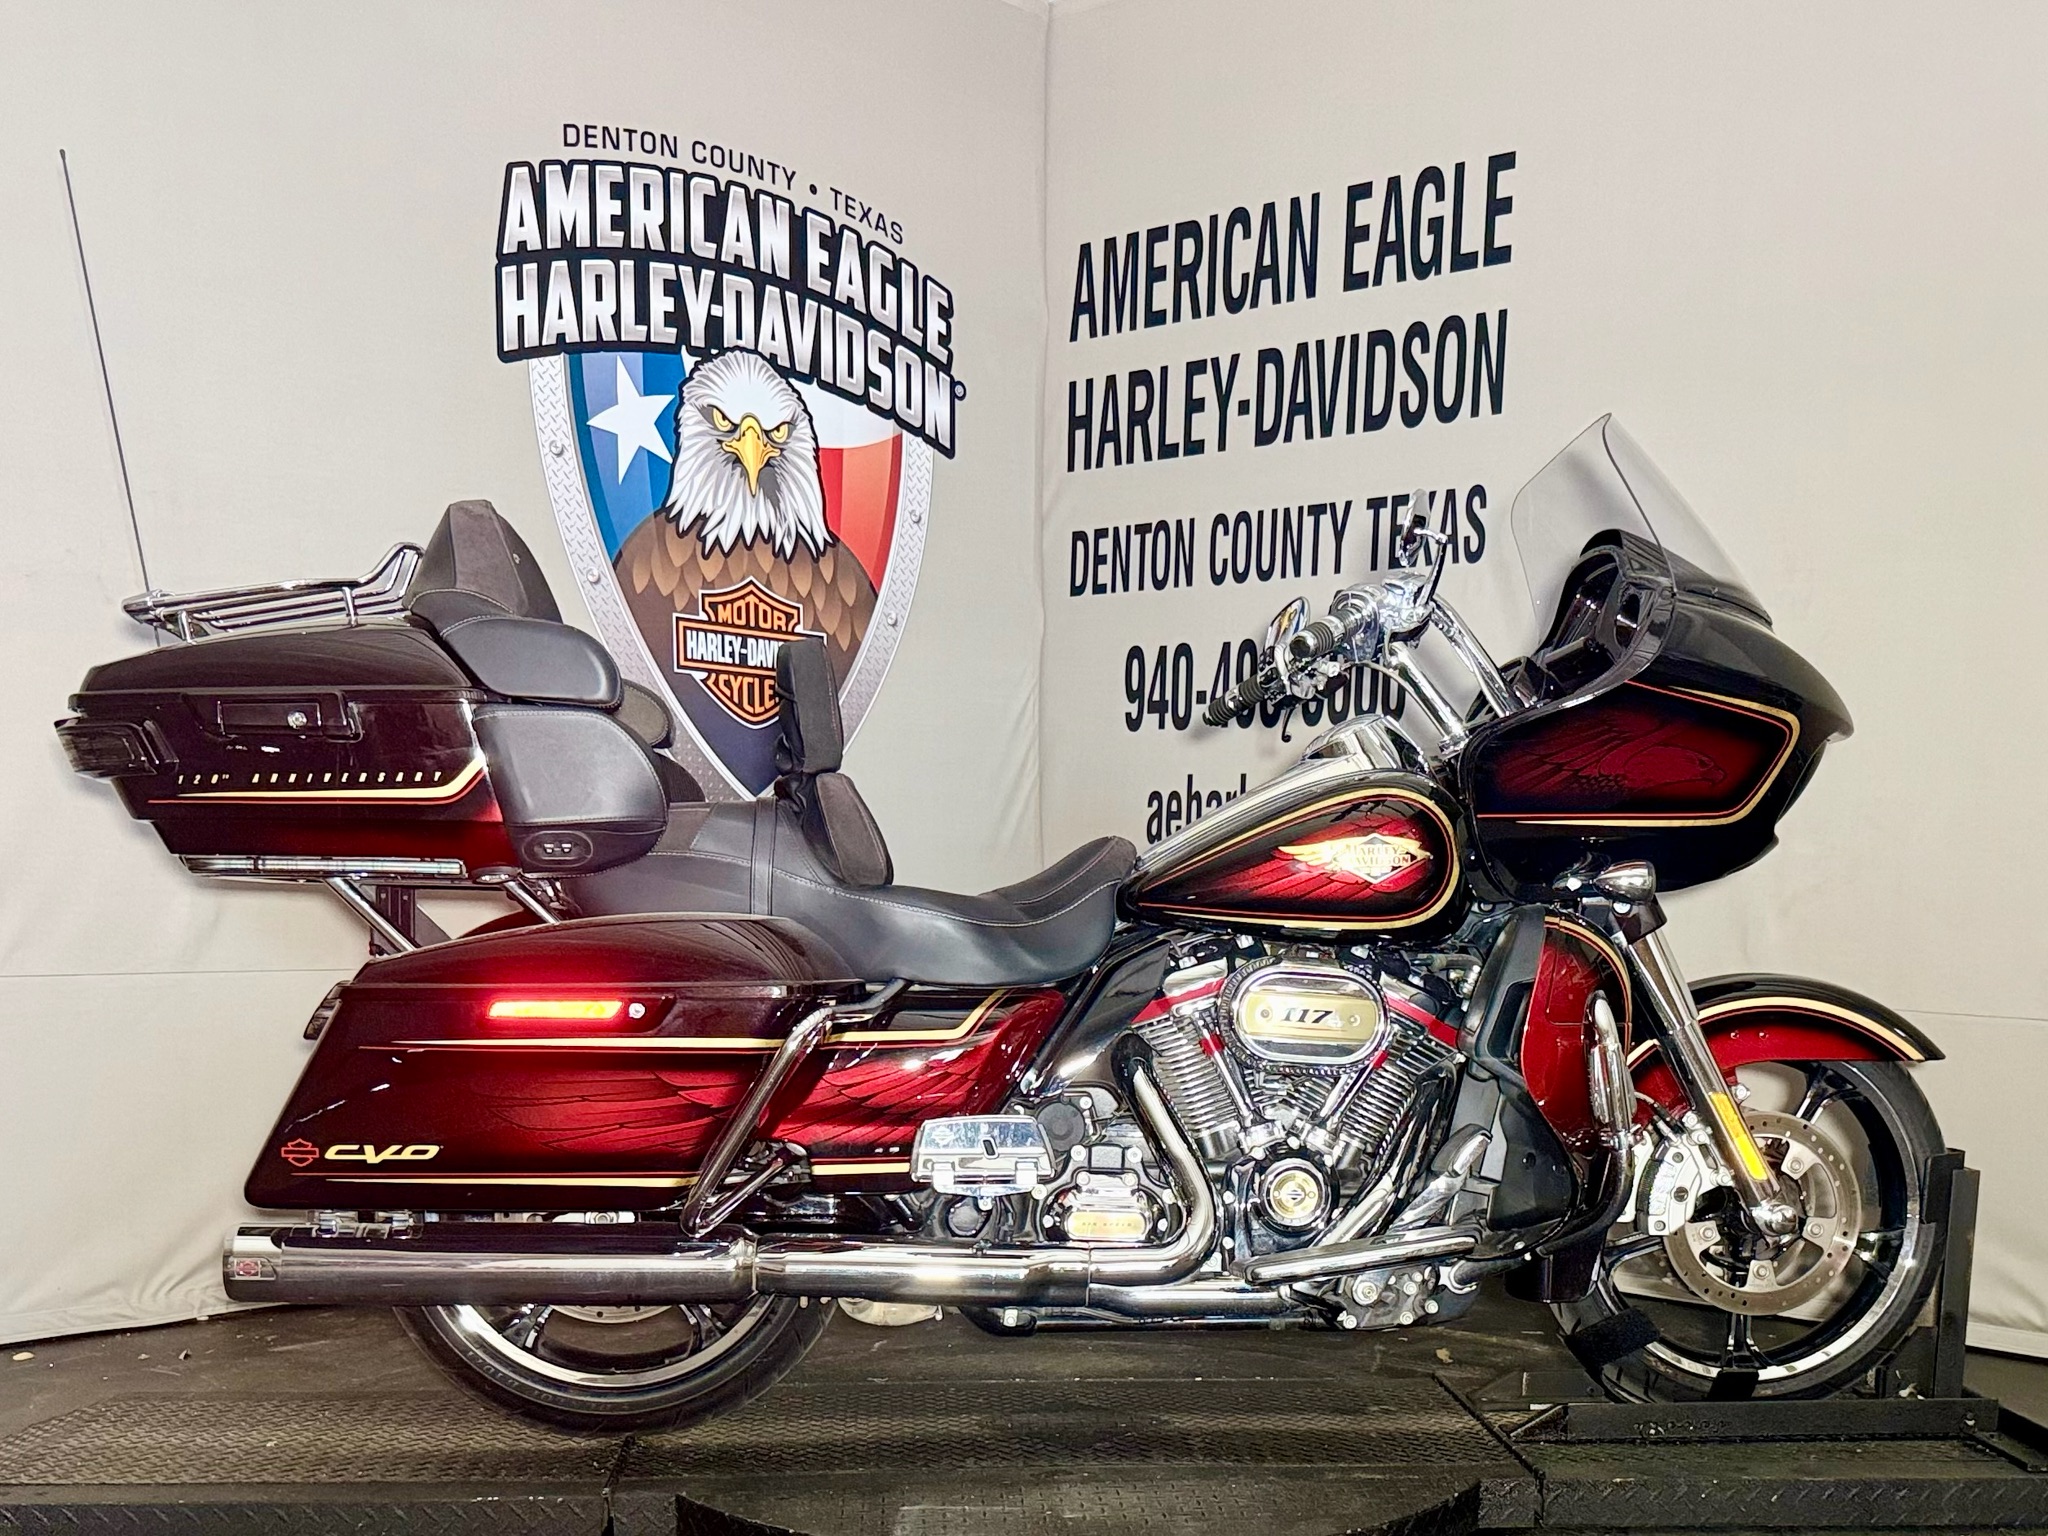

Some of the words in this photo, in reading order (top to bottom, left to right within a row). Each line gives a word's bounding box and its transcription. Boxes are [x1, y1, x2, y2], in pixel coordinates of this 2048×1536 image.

[563, 123, 678, 158] DENTON
[692, 141, 797, 191] COUNTY
[830, 187, 904, 245] TEXAS
[502, 163, 791, 281] AMERICAN
[806, 211, 950, 363] EAGLE
[1069, 192, 1321, 343] AMERICAN
[1342, 150, 1517, 293] EAGLE
[502, 259, 953, 449] HARLEY-DAVIDSON
[1066, 308, 1509, 473] HARLEY-DAVIDSON
[1069, 517, 1196, 598] DENTON
[1209, 500, 1353, 587] COUNTY
[685, 629, 784, 669] HARLEY-DAVI
[717, 594, 787, 632] MOTOR
[718, 673, 780, 714] CYCLE
[1281, 1009, 1334, 1024] 117
[323, 1144, 441, 1164] CVO
